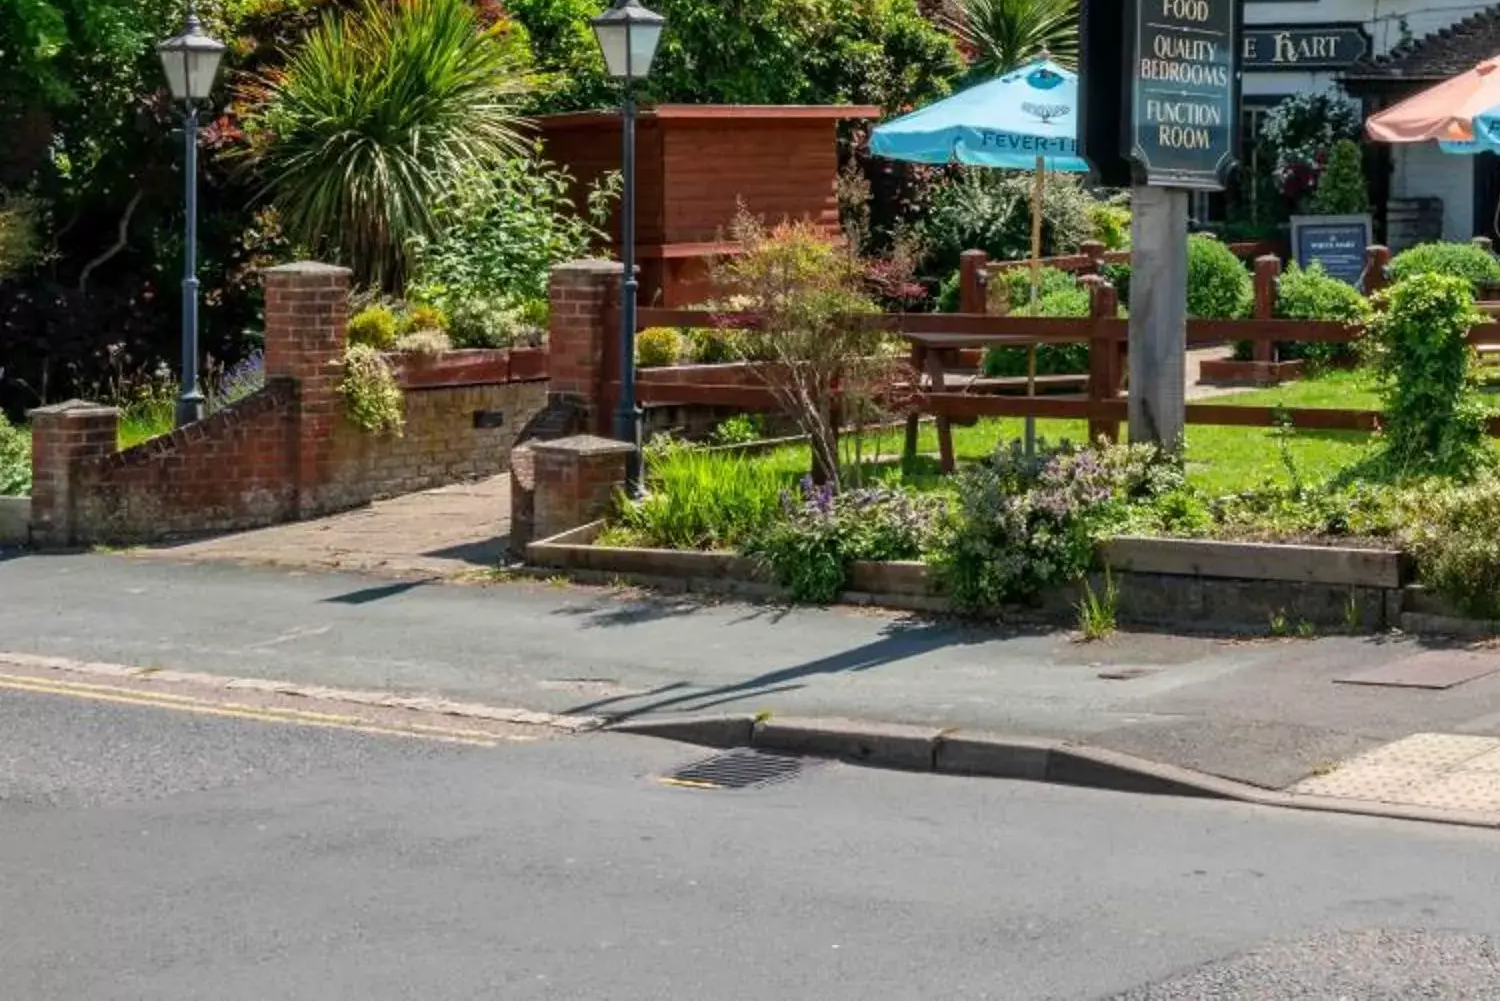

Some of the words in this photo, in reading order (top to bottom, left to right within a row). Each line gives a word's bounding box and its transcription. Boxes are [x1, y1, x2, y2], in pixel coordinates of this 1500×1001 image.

[1153, 34, 1217, 62] QUALITY
[1271, 30, 1341, 62] HART
[1141, 57, 1228, 87] BEDROOMS
[1147, 99, 1221, 126] FUNCTION
[1158, 125, 1210, 149] ROOM
